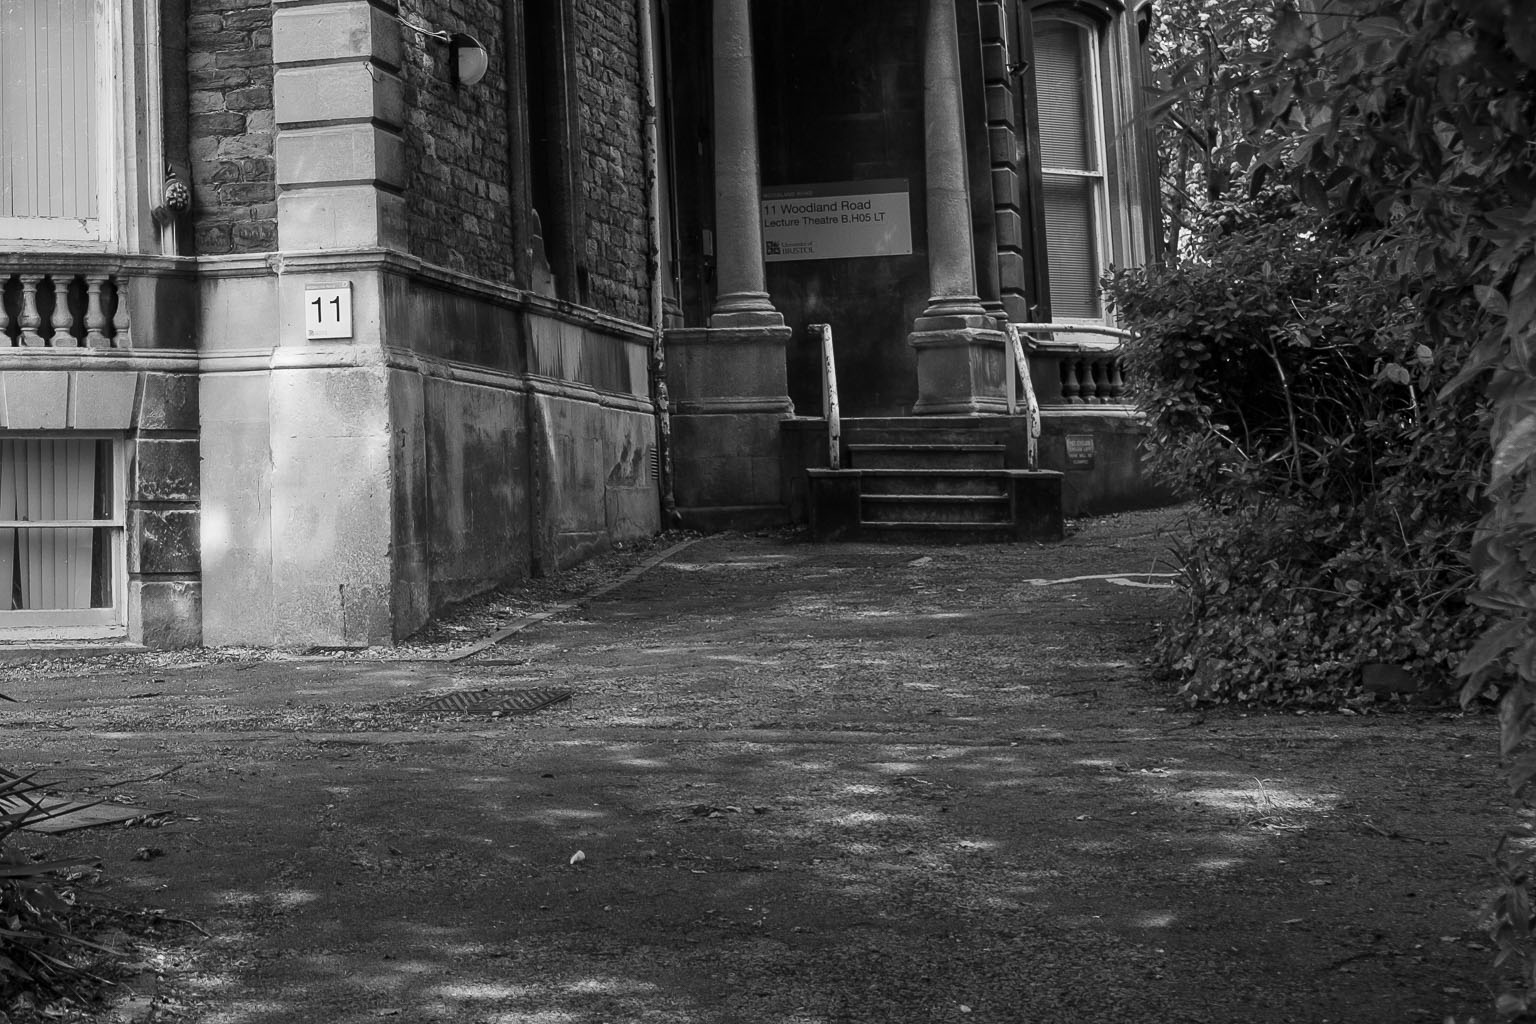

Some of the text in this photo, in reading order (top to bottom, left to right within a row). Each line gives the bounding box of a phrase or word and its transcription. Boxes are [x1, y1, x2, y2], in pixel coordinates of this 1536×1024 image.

[780, 201, 837, 215] Woodland
[841, 199, 871, 211] Road
[764, 218, 800, 228] Lecture
[802, 215, 838, 225] Theatre
[874, 212, 886, 222] LT
[311, 295, 340, 323] 11
